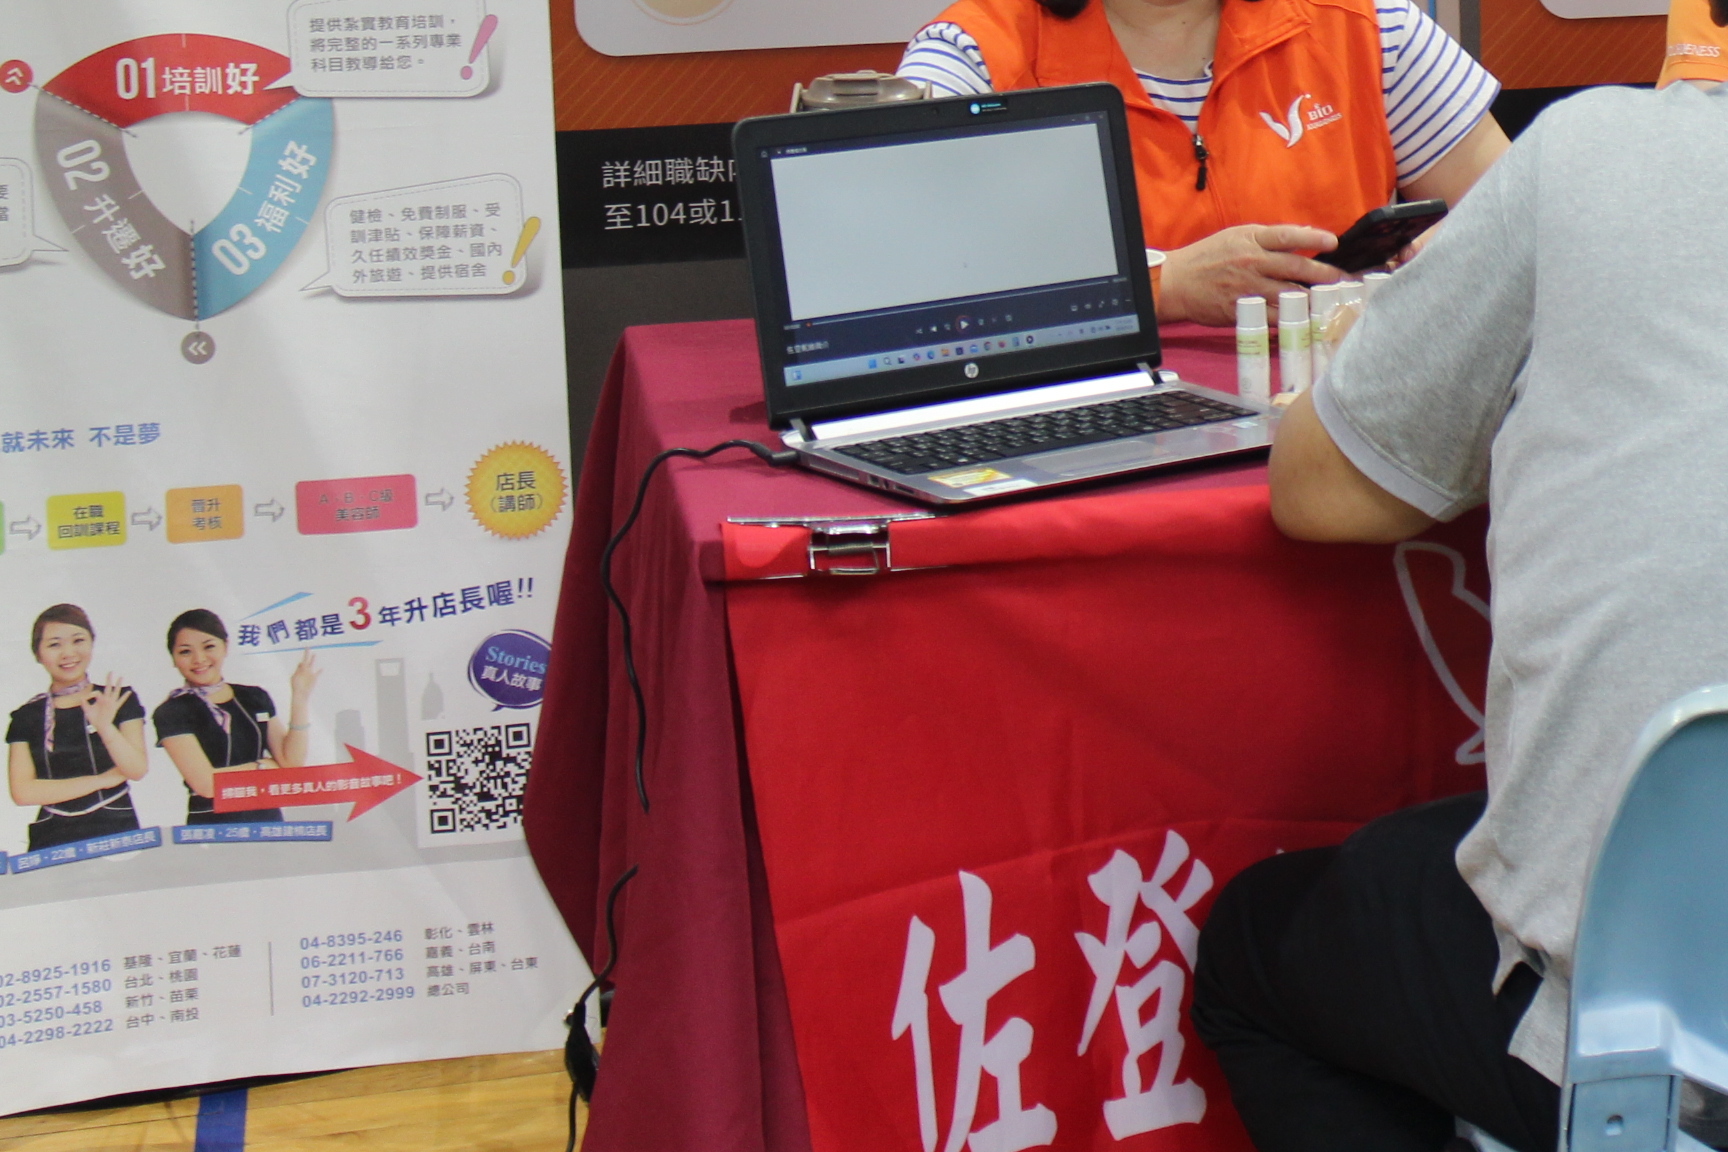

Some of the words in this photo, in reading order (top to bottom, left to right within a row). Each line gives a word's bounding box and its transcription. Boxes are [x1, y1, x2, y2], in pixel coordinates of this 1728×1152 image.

[604, 198, 743, 231] 至104或1
[89, 422, 162, 447] 不是夢
[496, 470, 536, 491] 店長
[72, 504, 104, 520] 在職
[335, 505, 381, 522] 美容師
[192, 515, 222, 531] 考核
[485, 645, 548, 674] Stories
[480, 665, 543, 691] 真人故事
[300, 929, 403, 950] 04-8395-246
[301, 948, 404, 969] 06-2211-766
[302, 967, 405, 989] 07-3120-713
[302, 985, 416, 1007] 04-2292-2999
[427, 981, 470, 998] 總公司
